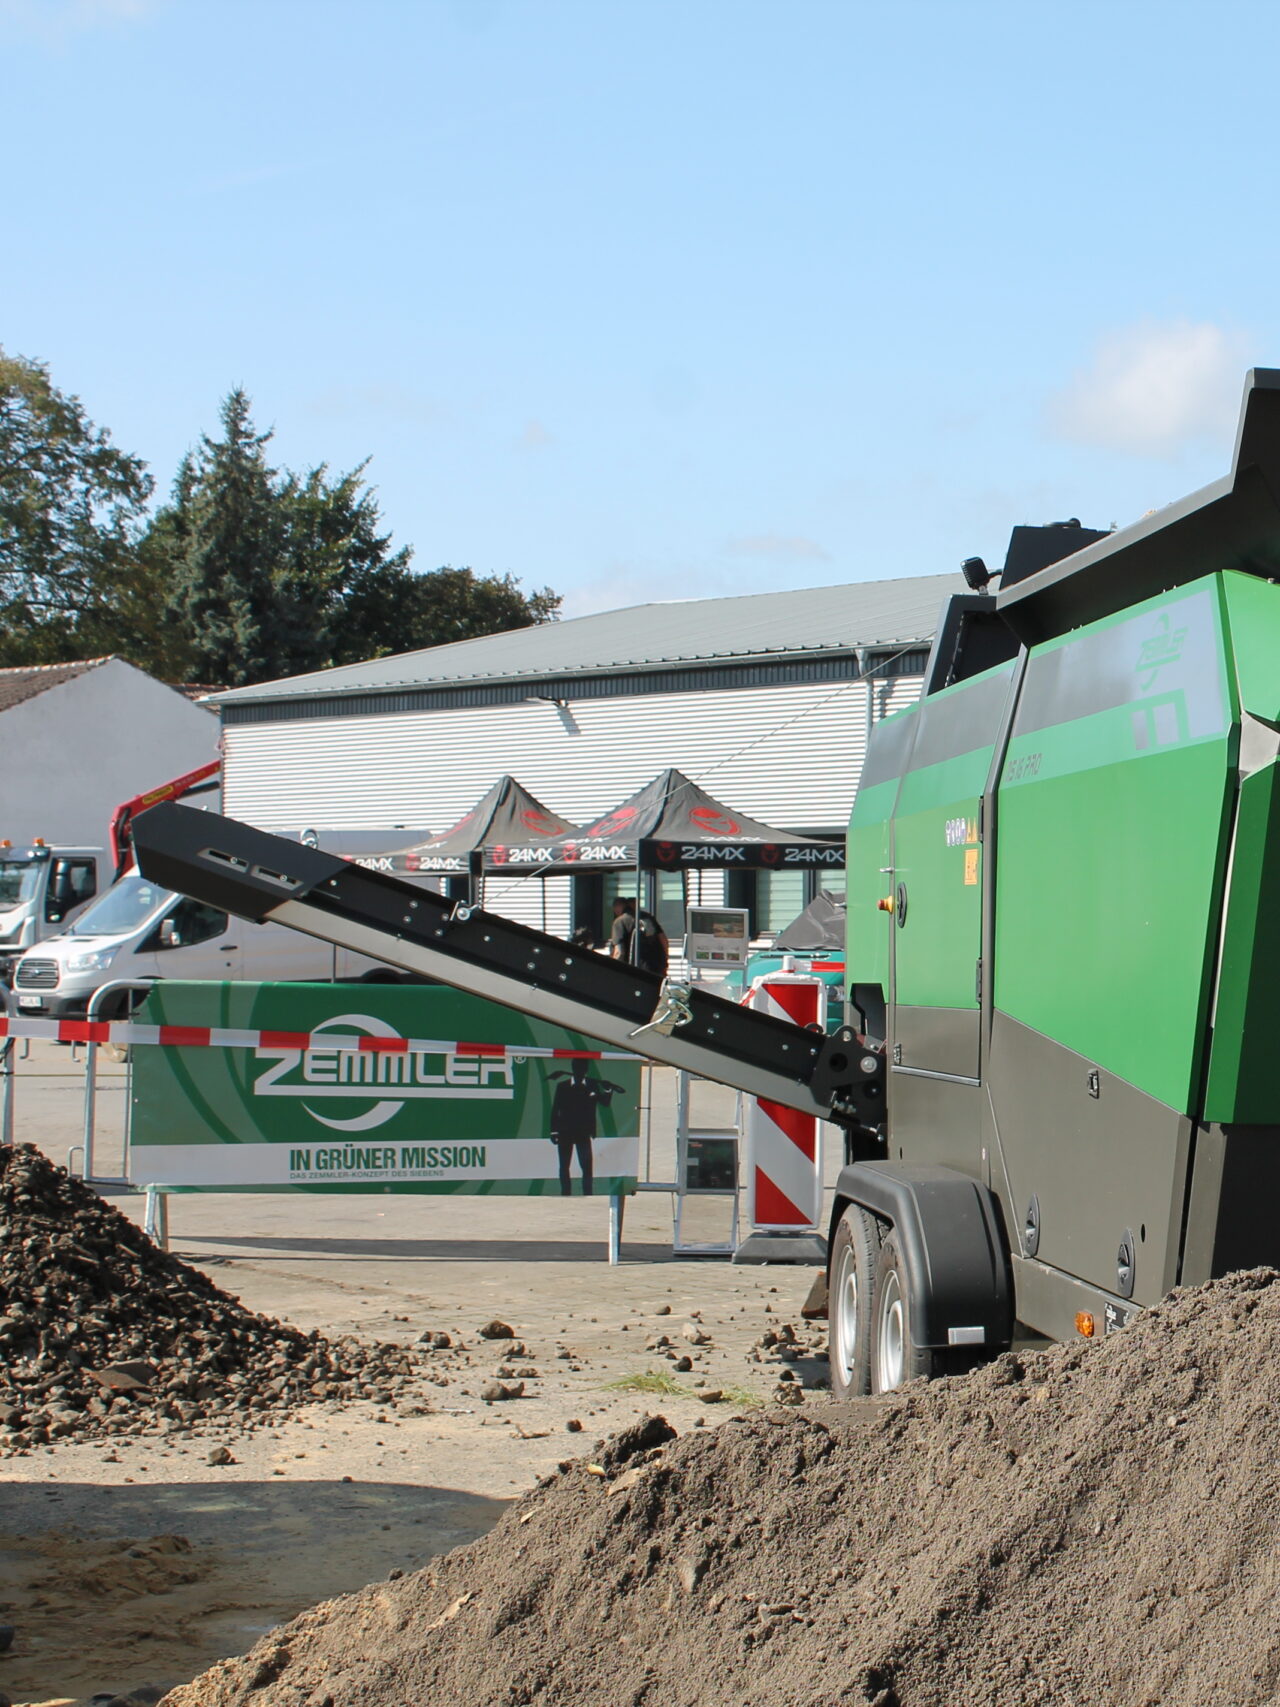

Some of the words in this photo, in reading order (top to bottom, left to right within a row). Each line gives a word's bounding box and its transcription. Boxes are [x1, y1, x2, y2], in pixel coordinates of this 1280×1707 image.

[508, 847, 553, 862] 24MX
[580, 845, 627, 860] 24MX
[680, 846, 746, 861] 24MX
[784, 848, 845, 863] 24MX
[420, 856, 461, 870] 24MX
[289, 1149, 311, 1171] IN
[315, 1143, 396, 1170] GRÜNER
[400, 1146, 487, 1169] MISSION
[290, 1172, 307, 1180] DAS
[392, 1170, 408, 1178] DES
[410, 1169, 445, 1178] SIEBENS
